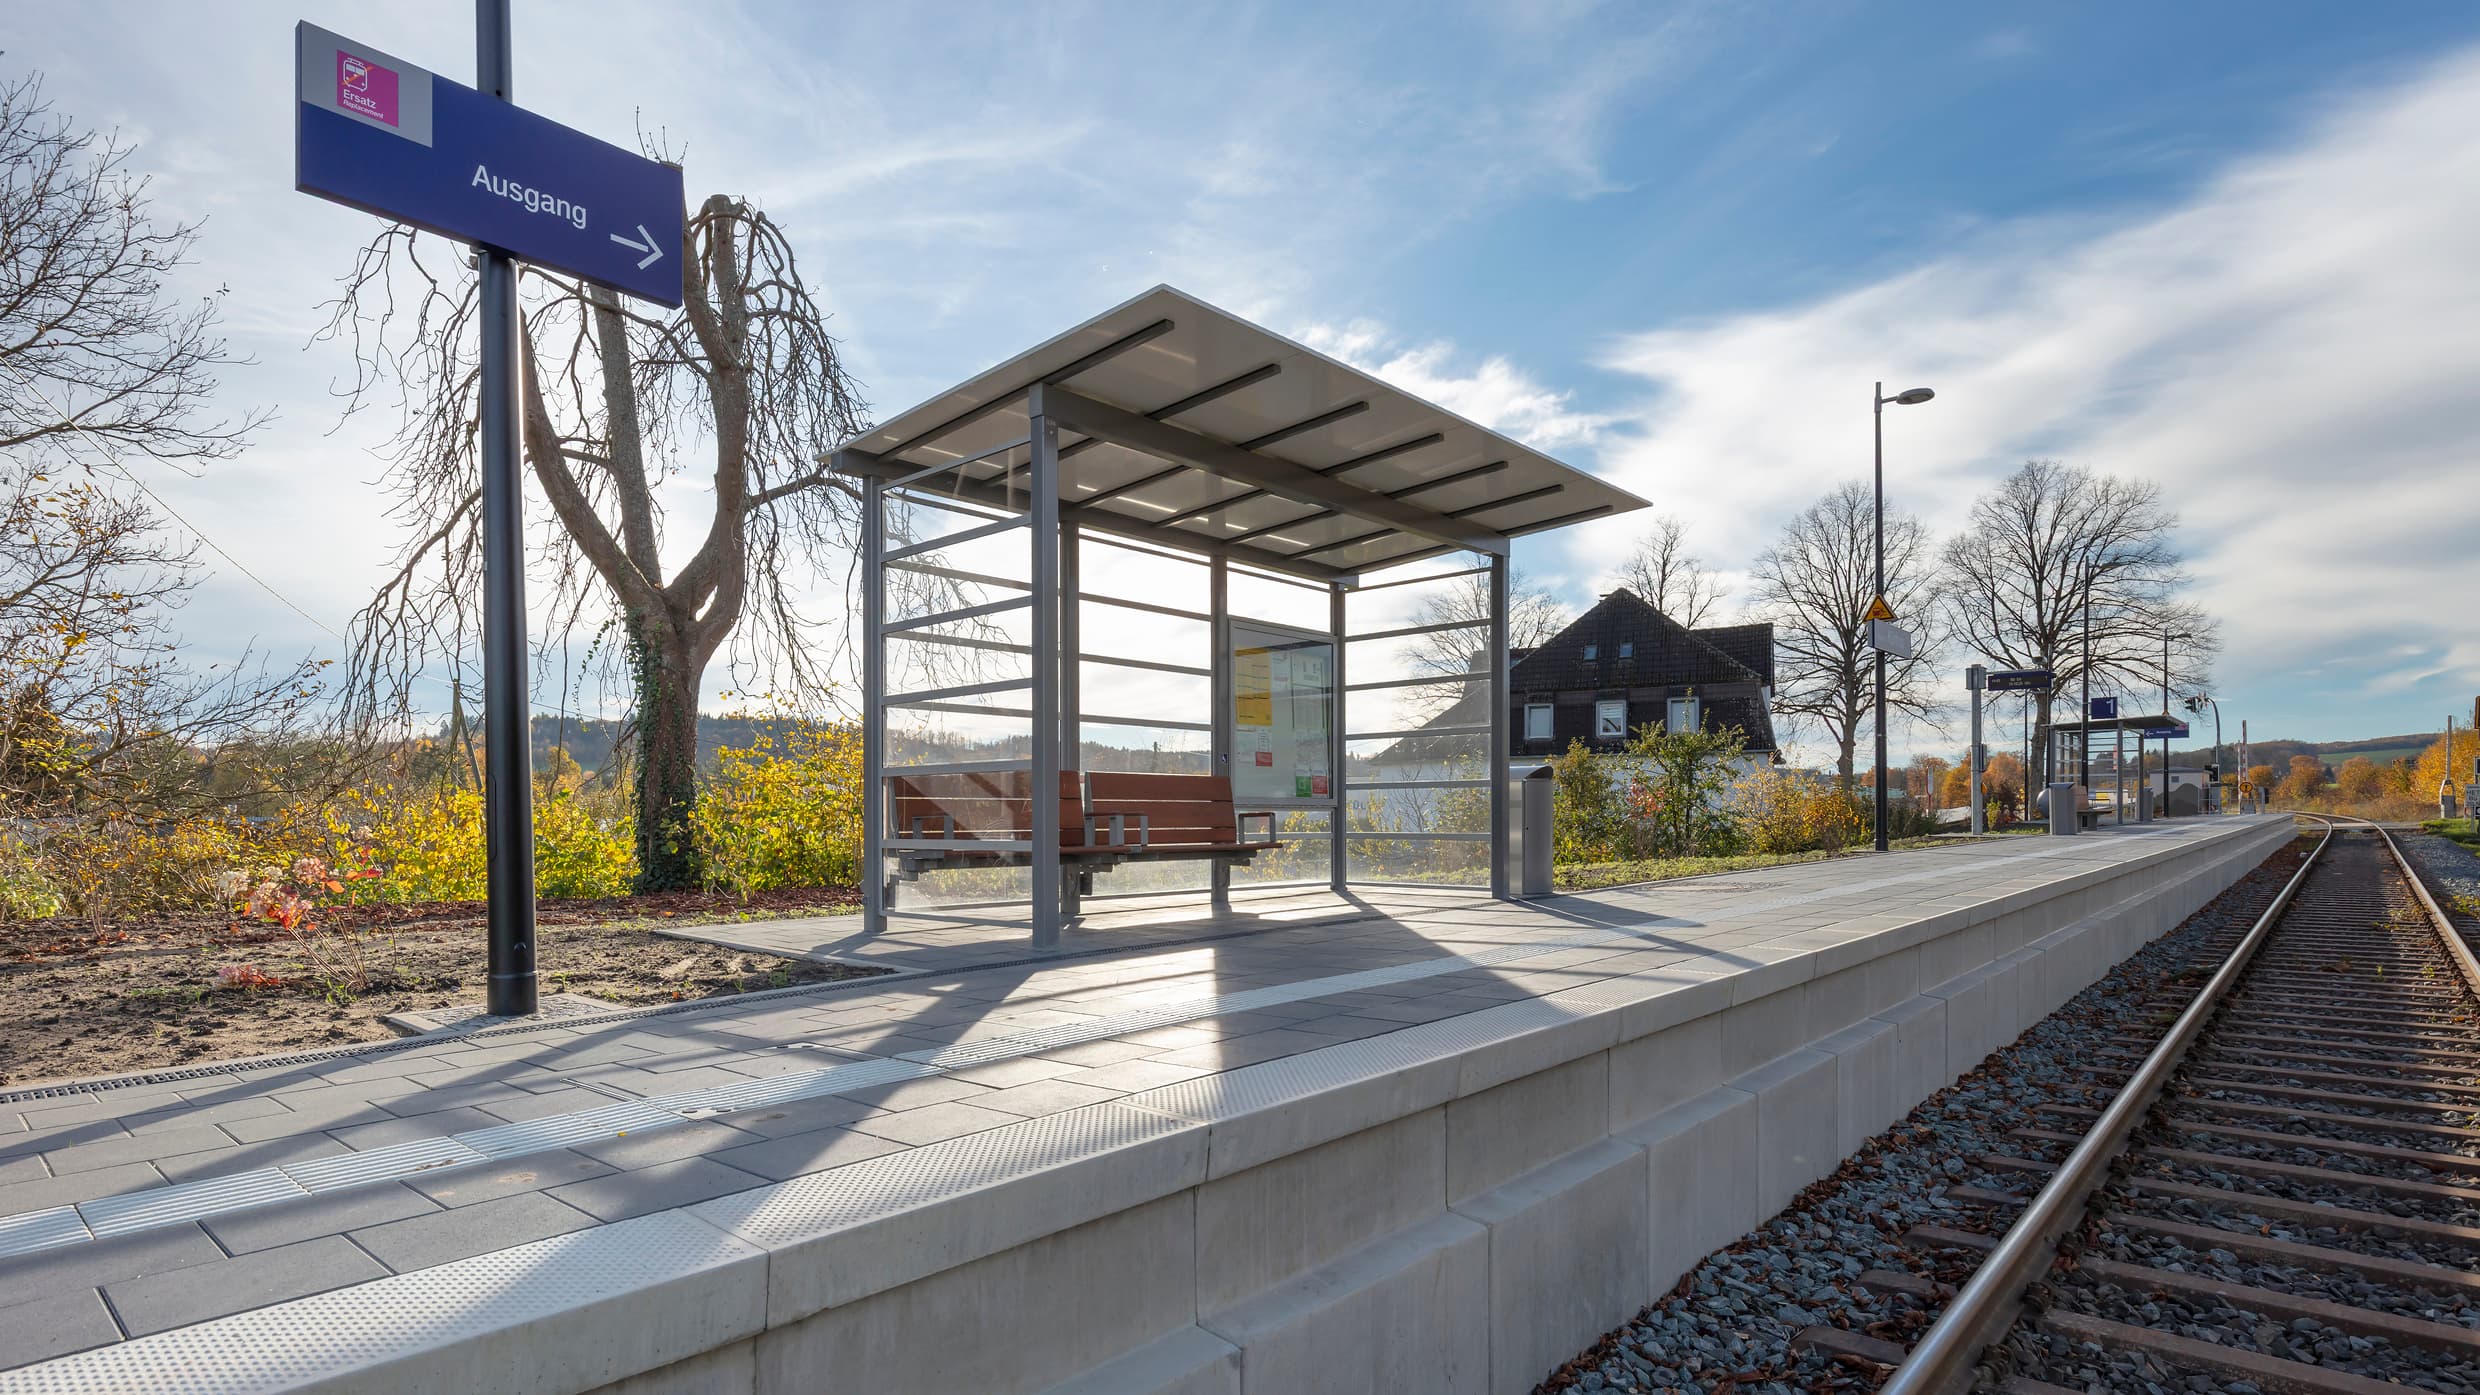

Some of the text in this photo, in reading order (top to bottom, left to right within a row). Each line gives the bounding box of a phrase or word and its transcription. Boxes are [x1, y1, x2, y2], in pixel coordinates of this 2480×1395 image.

[343, 88, 376, 109] Ersatz
[343, 99, 384, 119] Replacement
[471, 164, 587, 229] Ausgang
[2106, 699, 2114, 714] 1
